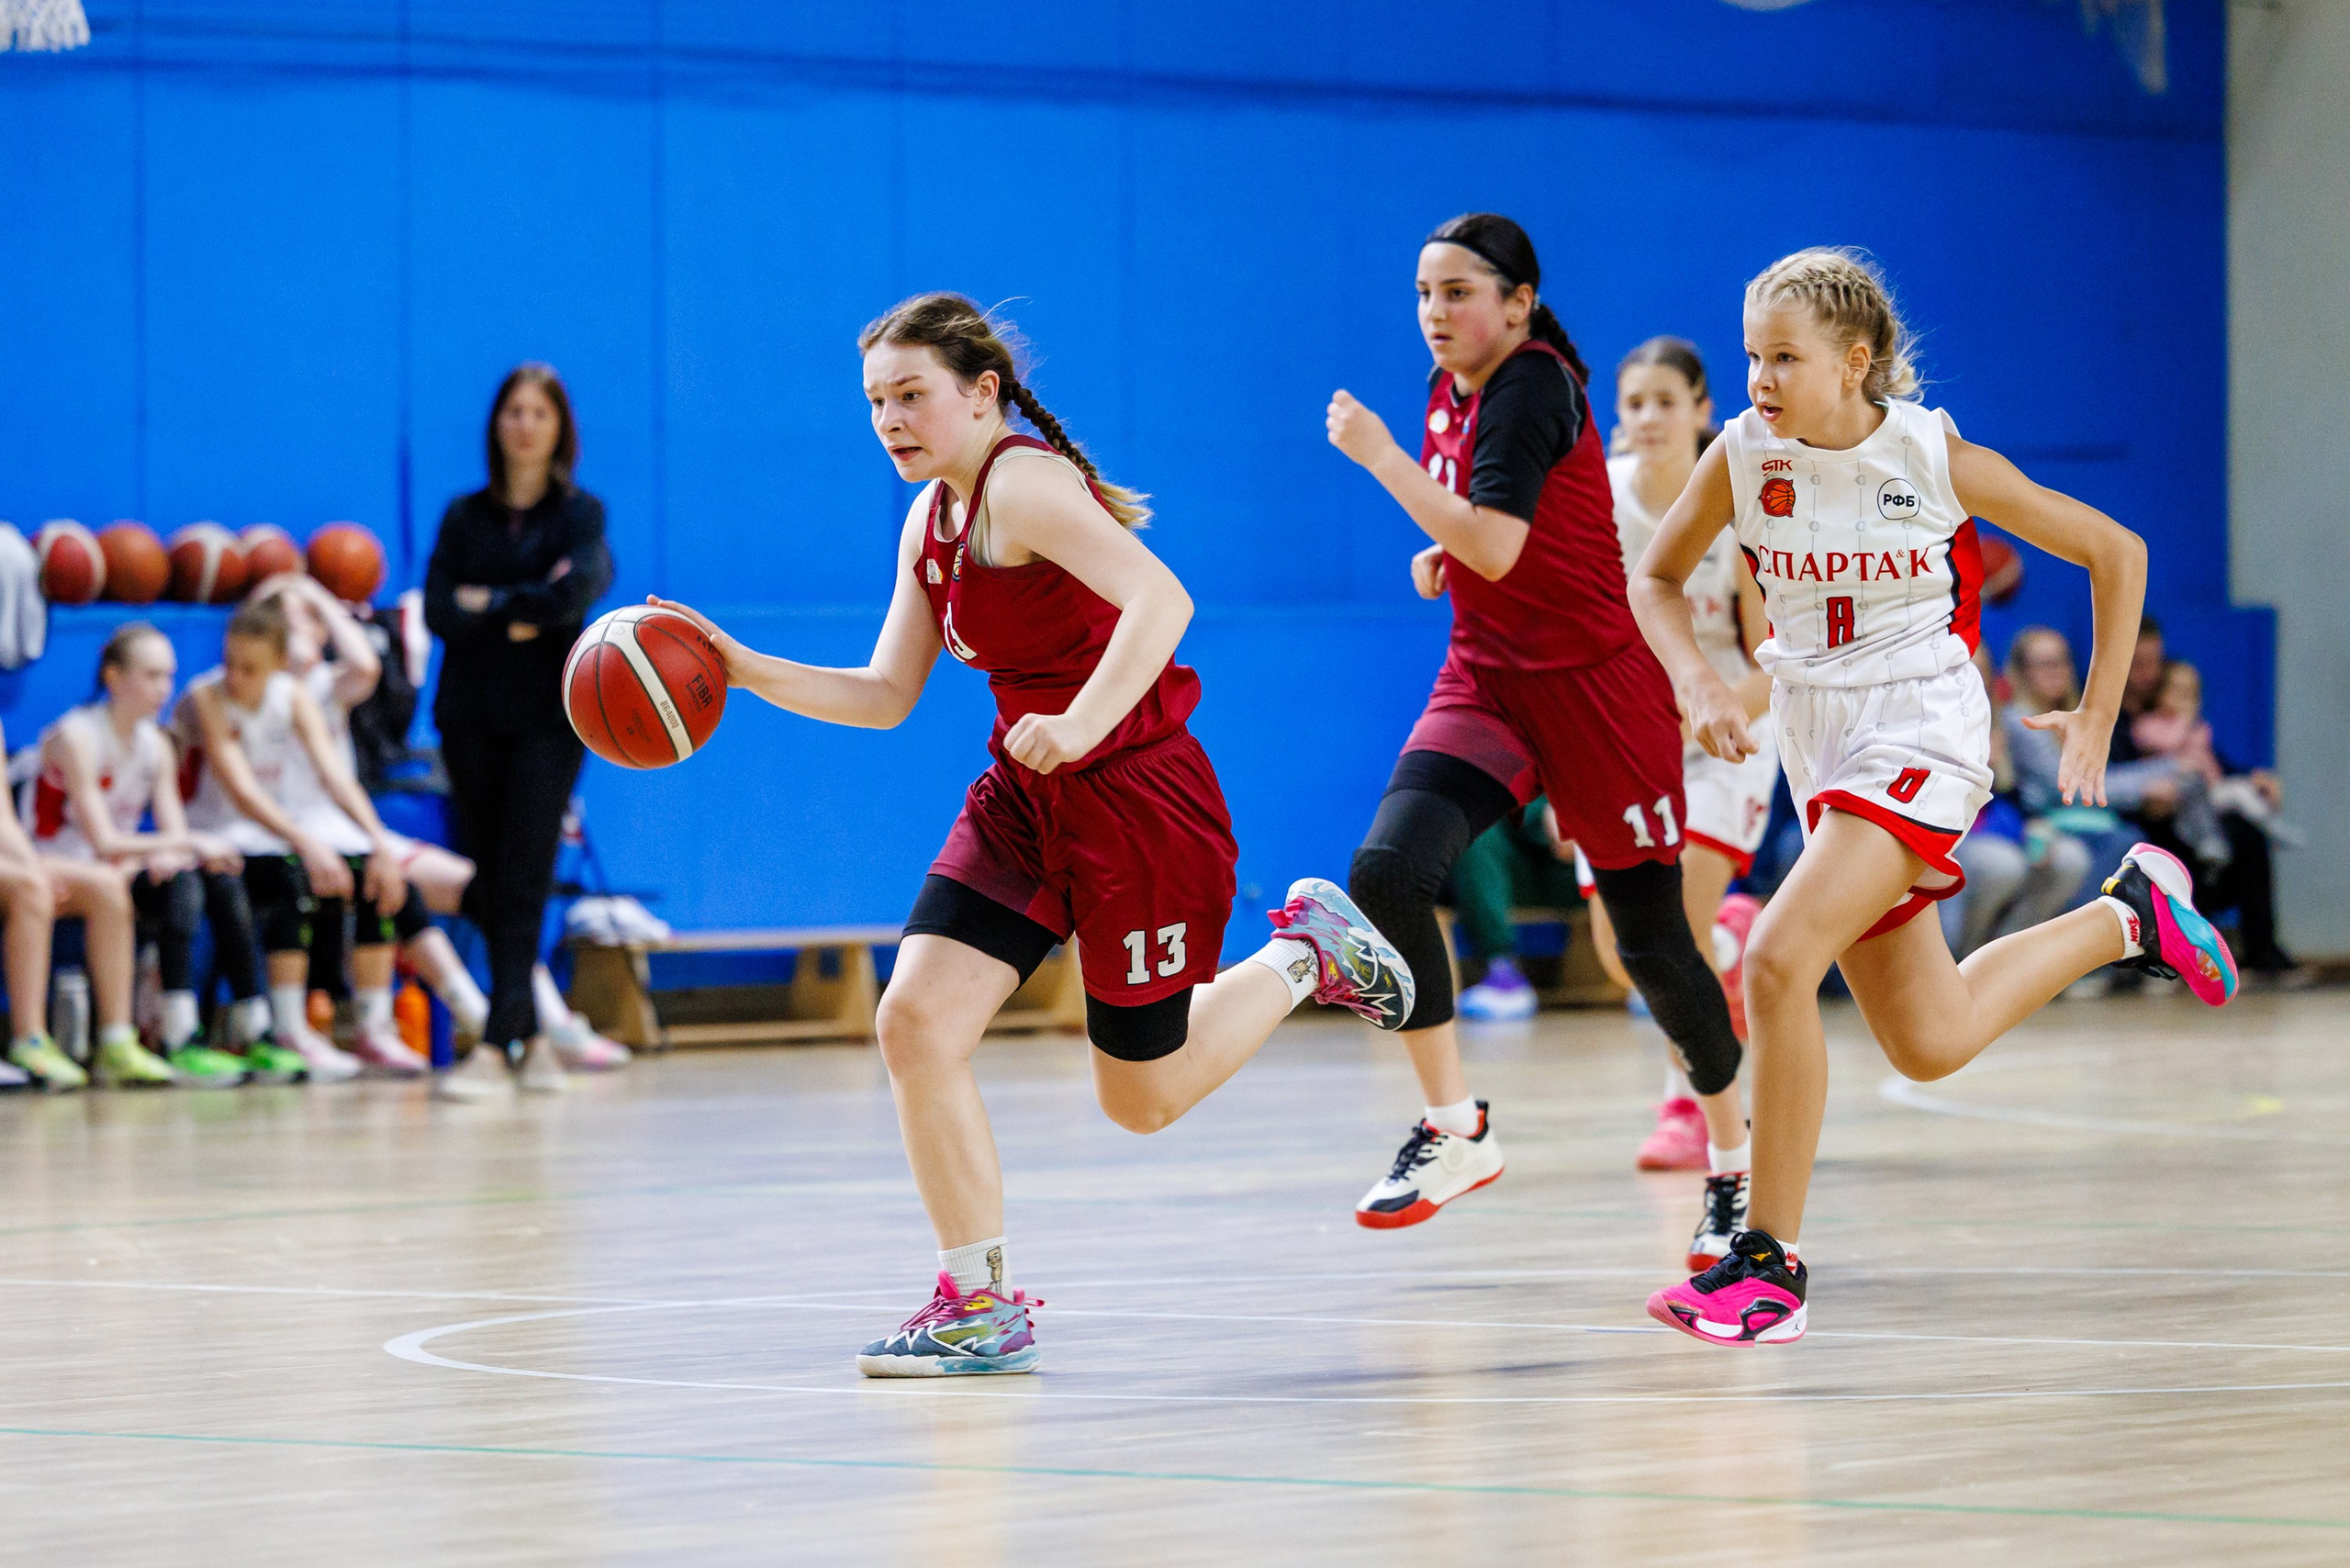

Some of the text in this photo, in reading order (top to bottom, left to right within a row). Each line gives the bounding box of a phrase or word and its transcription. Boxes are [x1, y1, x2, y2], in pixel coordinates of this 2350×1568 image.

[1883, 493, 1916, 508] РФБ
[691, 673, 713, 708] FIBA
[1622, 794, 1680, 848] 11
[1122, 922, 1187, 985] 13
